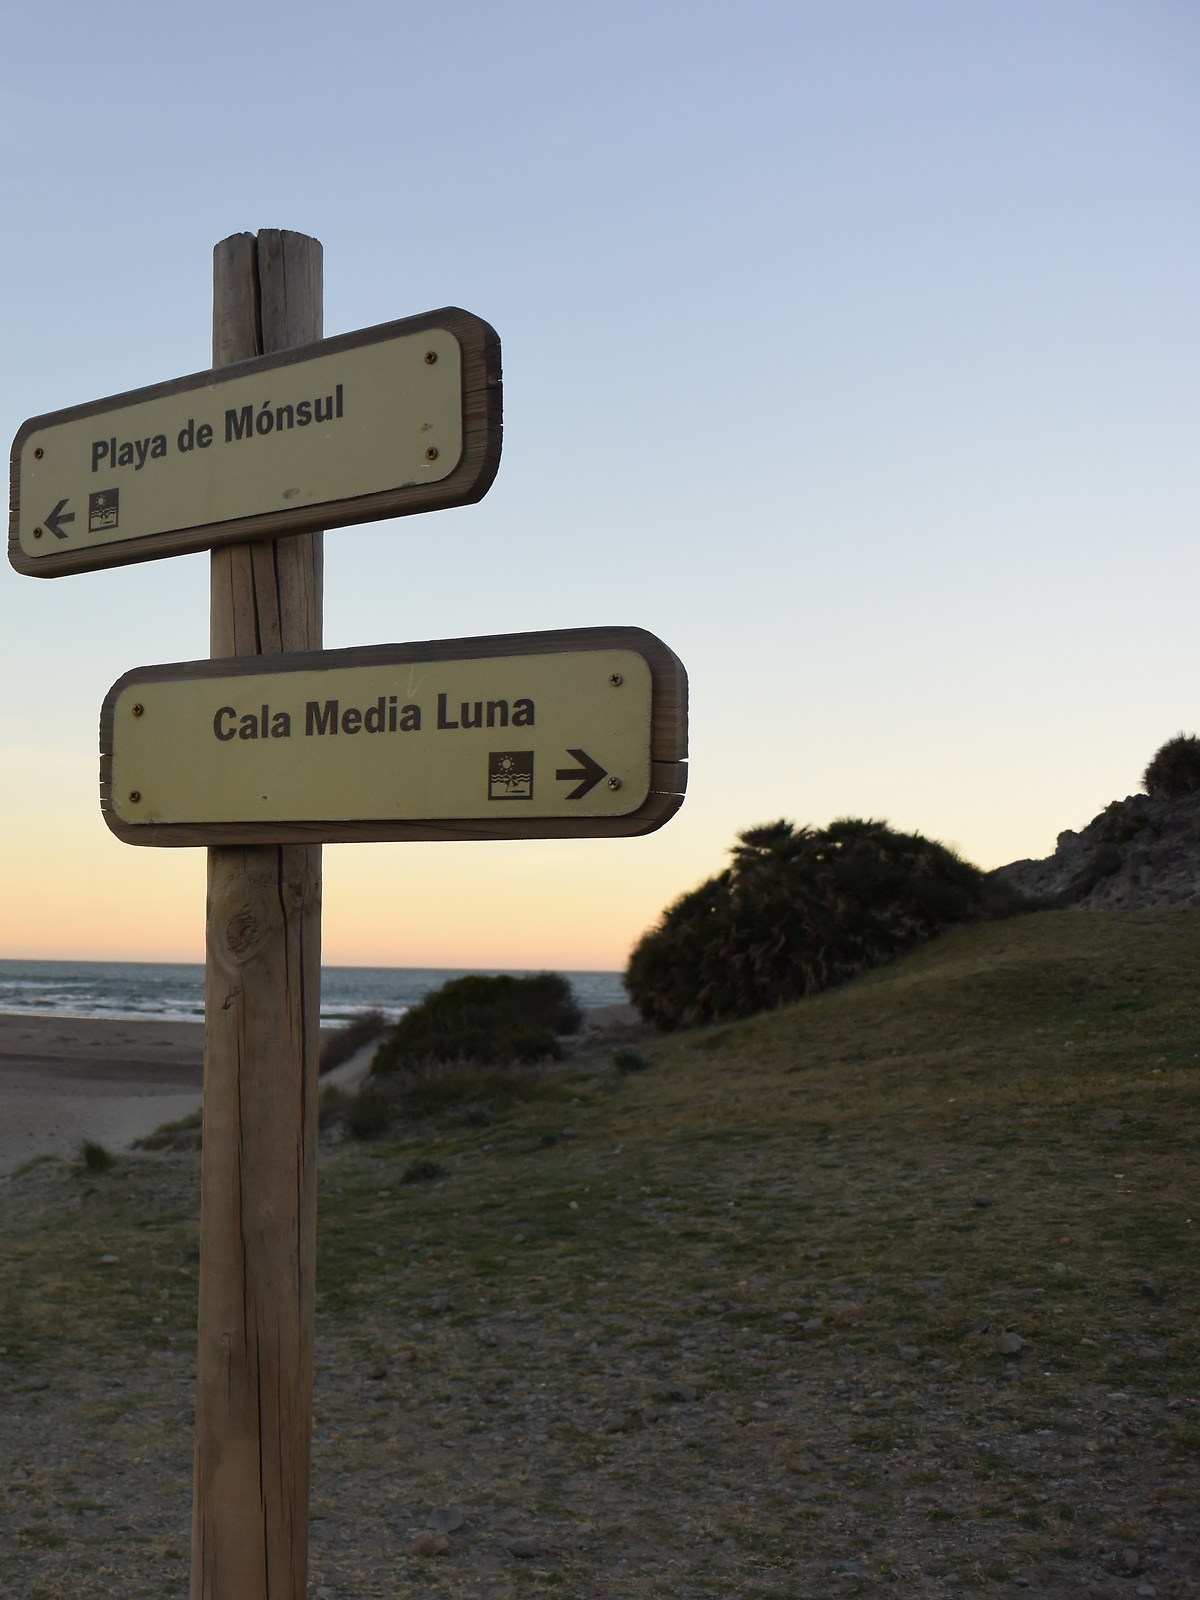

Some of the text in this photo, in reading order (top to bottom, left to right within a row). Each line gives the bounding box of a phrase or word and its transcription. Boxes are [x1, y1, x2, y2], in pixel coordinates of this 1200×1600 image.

[92, 384, 344, 472] Playa de Mónsul
[214, 693, 534, 741] Cala Media Luna
